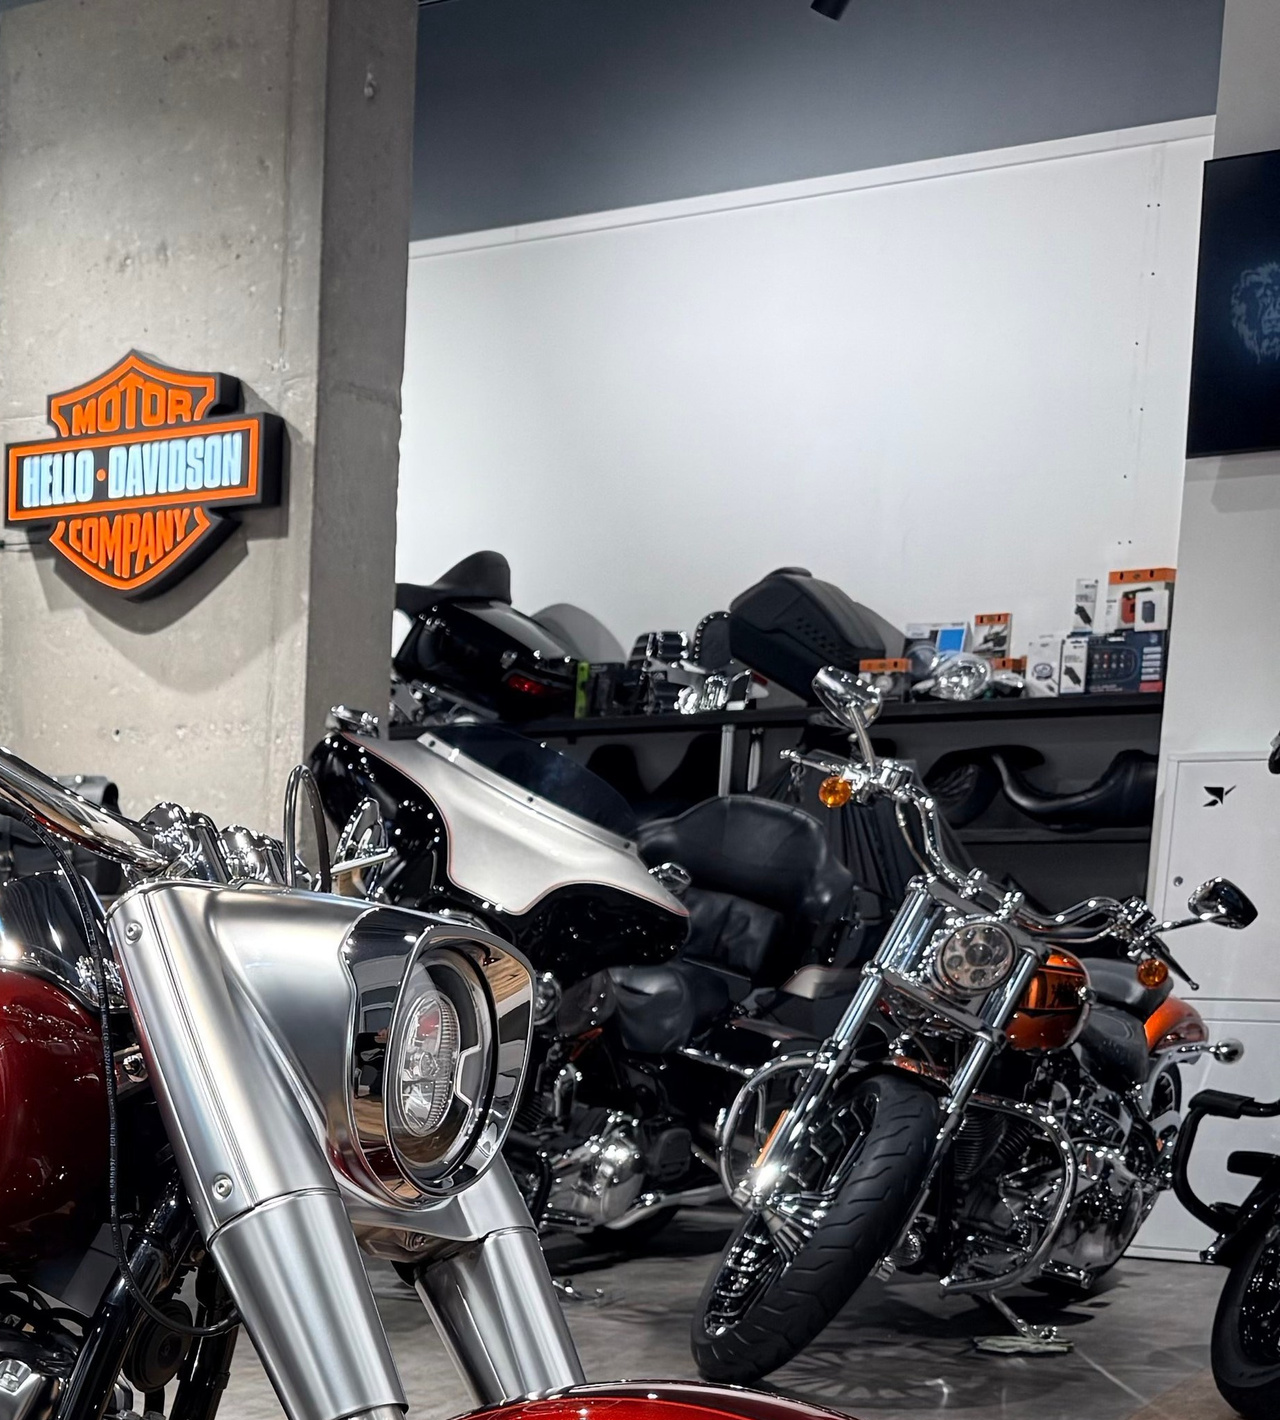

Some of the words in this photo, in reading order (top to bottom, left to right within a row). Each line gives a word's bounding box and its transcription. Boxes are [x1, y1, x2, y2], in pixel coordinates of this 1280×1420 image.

[72, 372, 192, 436] MOTOR
[23, 450, 94, 508] HELLO
[108, 432, 243, 499] DAVIDSON
[69, 507, 191, 579] COMPANY
